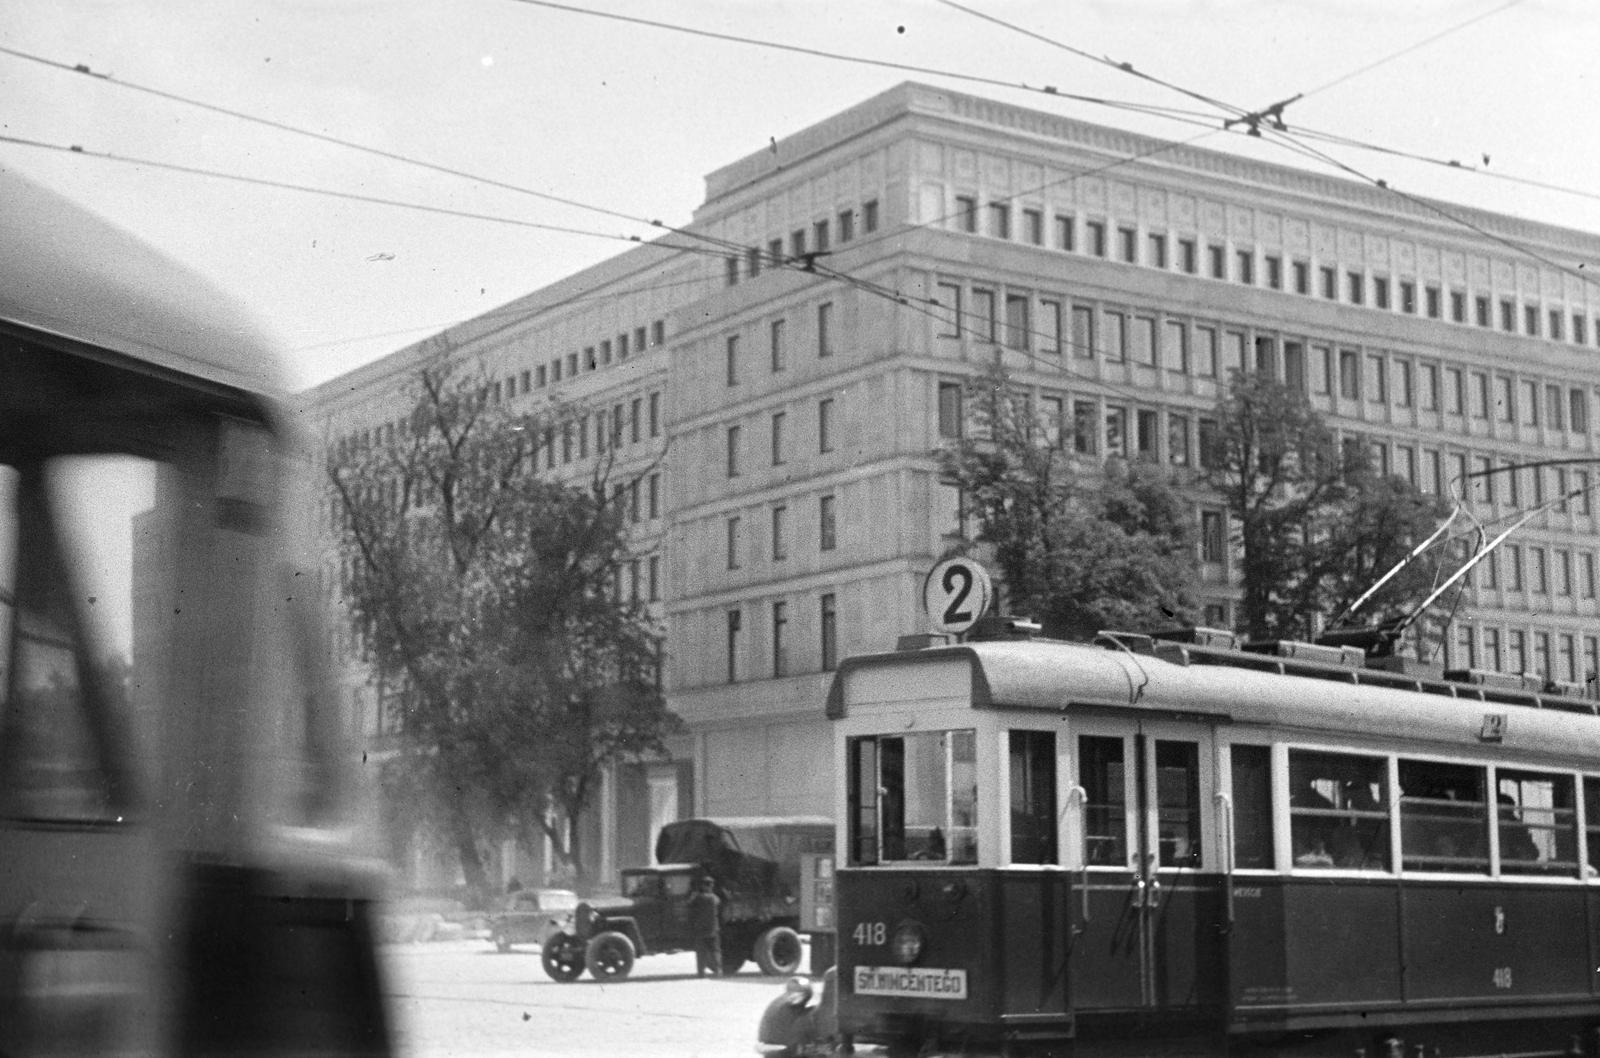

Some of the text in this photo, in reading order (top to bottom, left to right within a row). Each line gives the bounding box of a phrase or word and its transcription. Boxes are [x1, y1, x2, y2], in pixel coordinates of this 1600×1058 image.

[942, 564, 973, 624] 2
[1490, 715, 1502, 735] 2
[852, 922, 886, 945] 418
[1492, 966, 1512, 988] 418
